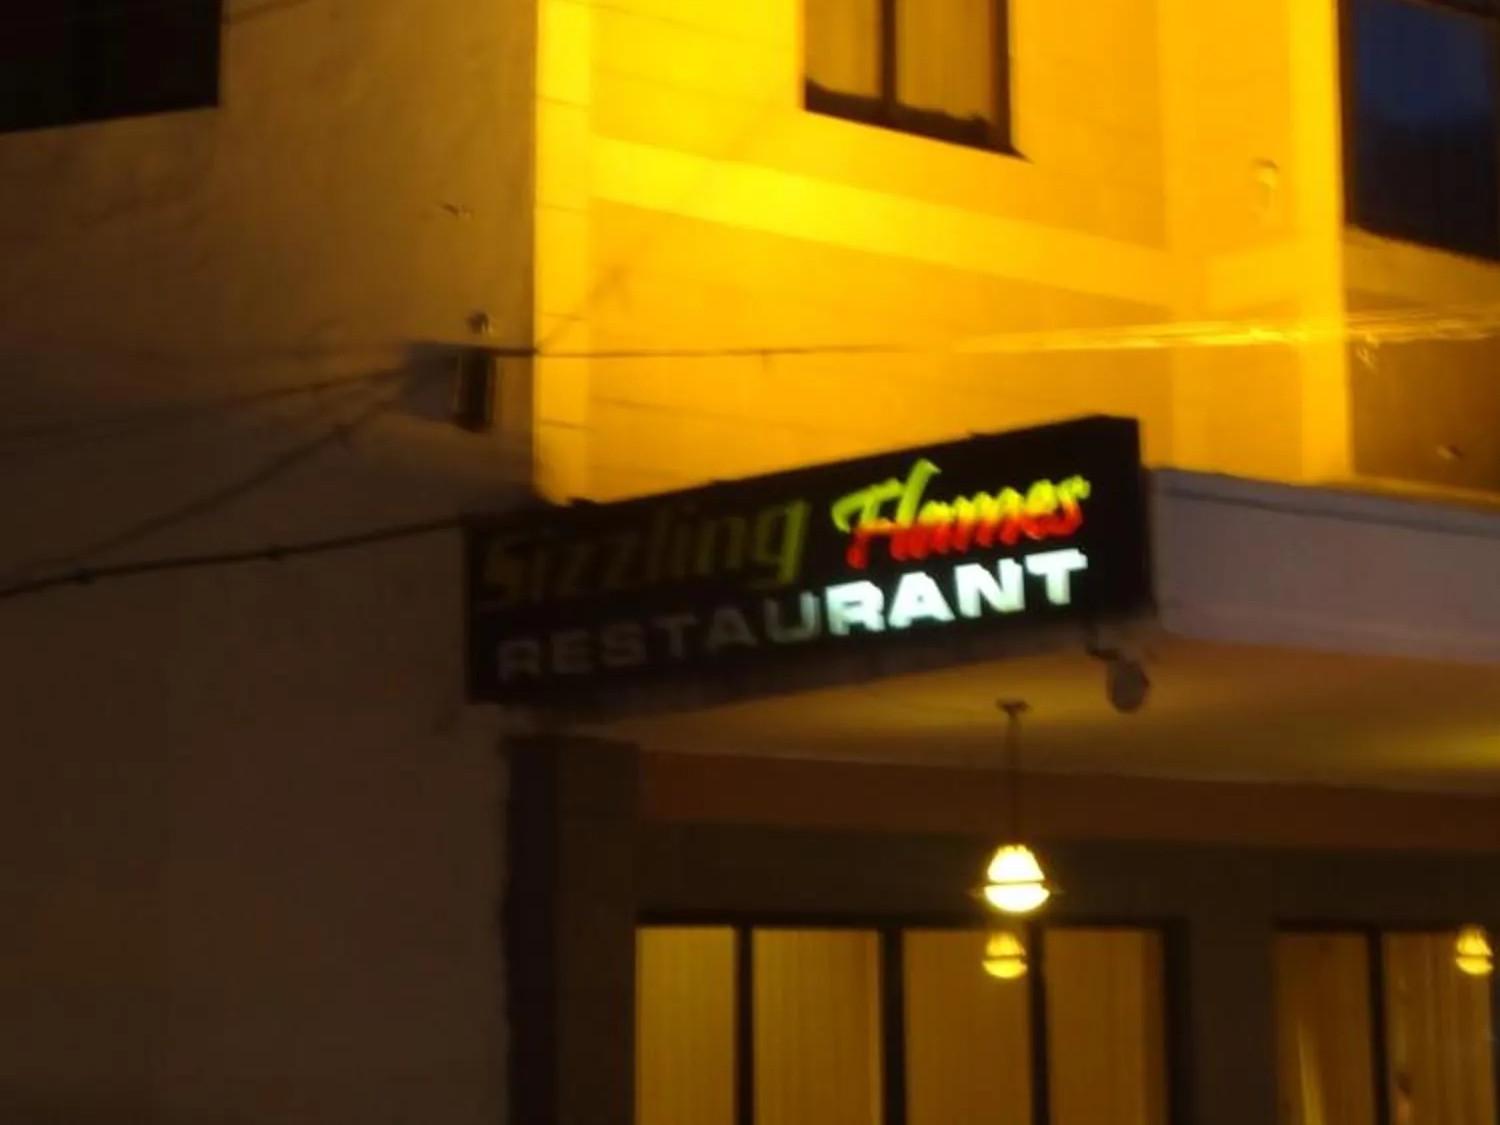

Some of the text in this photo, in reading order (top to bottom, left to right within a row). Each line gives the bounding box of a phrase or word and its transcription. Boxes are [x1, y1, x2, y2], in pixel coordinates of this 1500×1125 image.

[480, 457, 1092, 609] Sizzling Flames
[497, 547, 1090, 683] RESTAURANT
